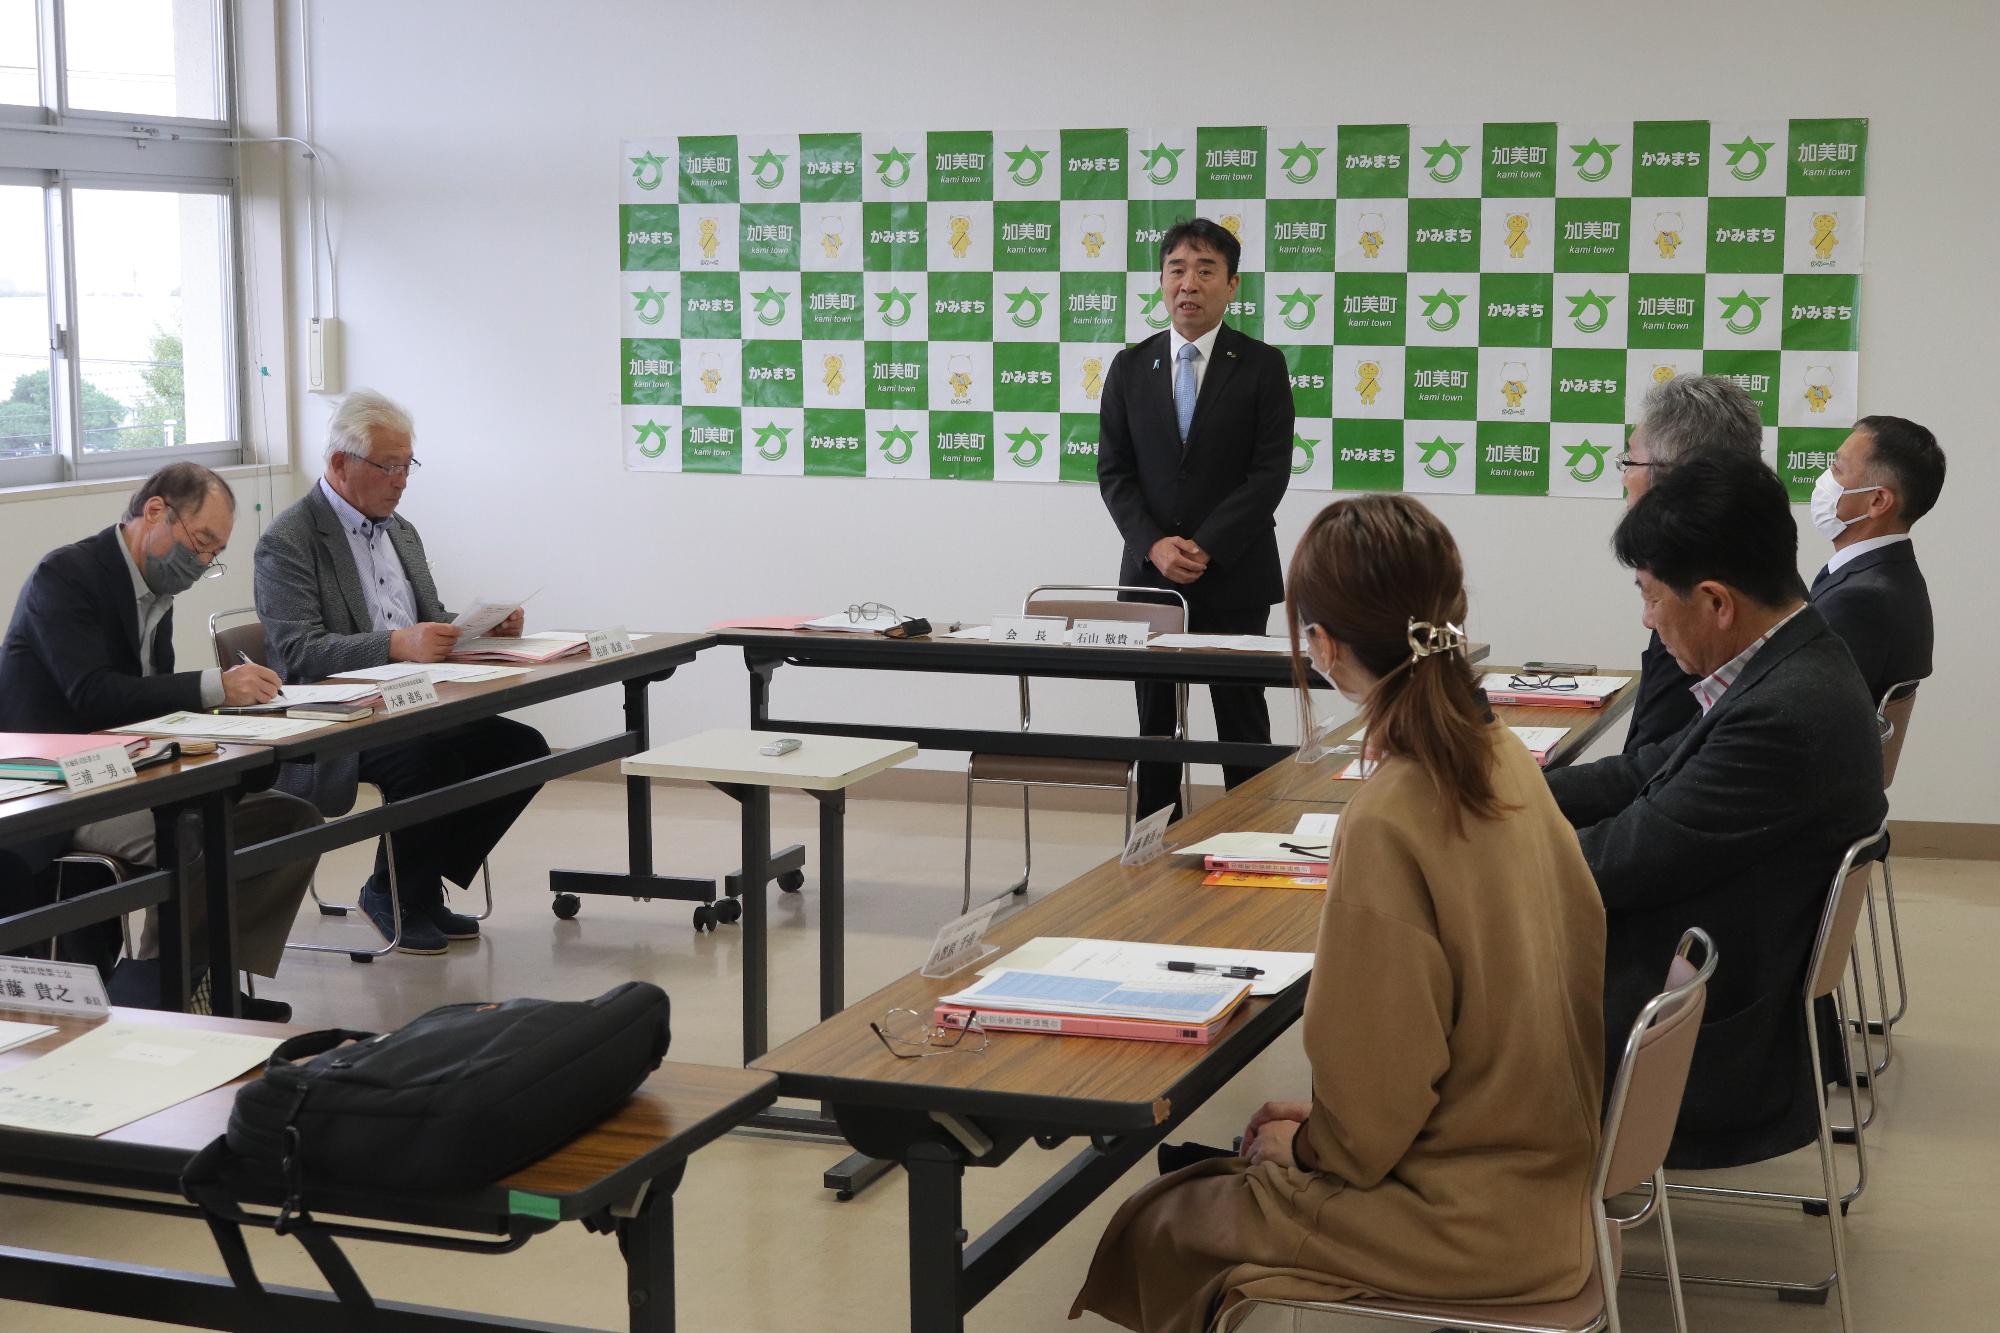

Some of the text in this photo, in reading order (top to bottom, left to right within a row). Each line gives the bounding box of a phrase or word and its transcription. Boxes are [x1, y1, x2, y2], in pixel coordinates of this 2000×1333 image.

[1205, 149, 1257, 168] 加美町
[1491, 146, 1547, 165] 加美町
[1798, 142, 1857, 162] 加美町
[687, 157, 731, 174] 加美町
[936, 153, 984, 171] 加美町
[1068, 157, 1120, 172] かみまち
[1345, 154, 1401, 170] かみまち
[1641, 152, 1700, 167] かみまち
[807, 161, 855, 175] かみまち
[1497, 170, 1542, 179] kami town
[1802, 167, 1852, 177] kami town
[691, 178, 729, 187] kami town
[940, 174, 982, 184] kami town
[1210, 172, 1254, 181] kami town
[627, 231, 672, 245] かみまち
[747, 224, 793, 241] 加美町
[870, 230, 919, 244] かみまち
[1002, 223, 1051, 241] 加美町
[1135, 229, 1167, 243] かみ
[1274, 222, 1327, 240] 加美町
[1416, 228, 1471, 243] かみまち
[1564, 221, 1619, 241] 加美町
[1716, 228, 1776, 243] かみまち
[751, 245, 789, 254] kami town
[1007, 245, 1048, 254] kami town
[1279, 245, 1323, 254] kami town
[1569, 244, 1616, 255] kami town
[687, 299, 734, 312] かみまち
[809, 293, 855, 311] 加美町
[935, 300, 985, 314] かみまち
[1068, 294, 1118, 312] 加美町
[1224, 301, 1256, 315] まち
[1344, 296, 1397, 314] 加美町
[1637, 297, 1695, 317] 加美町
[1487, 303, 1544, 318] かみまち
[1791, 305, 1852, 321] かみまち
[814, 314, 853, 323] kami town
[1073, 316, 1114, 325] kami town
[1348, 318, 1393, 328] kami town
[1642, 320, 1690, 331] kami town
[629, 359, 674, 375] 加美町
[748, 367, 796, 380] かみまち
[872, 363, 920, 380] 加美町
[633, 379, 671, 388] kami town
[1000, 370, 1052, 384] かみまち
[1414, 370, 1467, 388] 加美町
[1722, 373, 1770, 392] 美町
[877, 383, 917, 393] kami town
[1559, 377, 1617, 393] かみまち
[1419, 391, 1463, 401] kami town
[689, 427, 734, 444] 加美町
[937, 433, 985, 450] 加美町
[810, 436, 858, 450] かみまち
[693, 448, 732, 457] kami town
[942, 455, 983, 464] kami town
[1340, 446, 1396, 462] かみまち
[1485, 444, 1540, 463] 加美町
[1490, 467, 1536, 477] kami town
[1792, 475, 1815, 484] kami
[1077, 633, 1099, 644] 石山
[71, 769, 94, 787] 三浦
[97, 763, 118, 779] 一男
[0, 979, 26, 998] 藤
[34, 982, 75, 1003] 貴之
